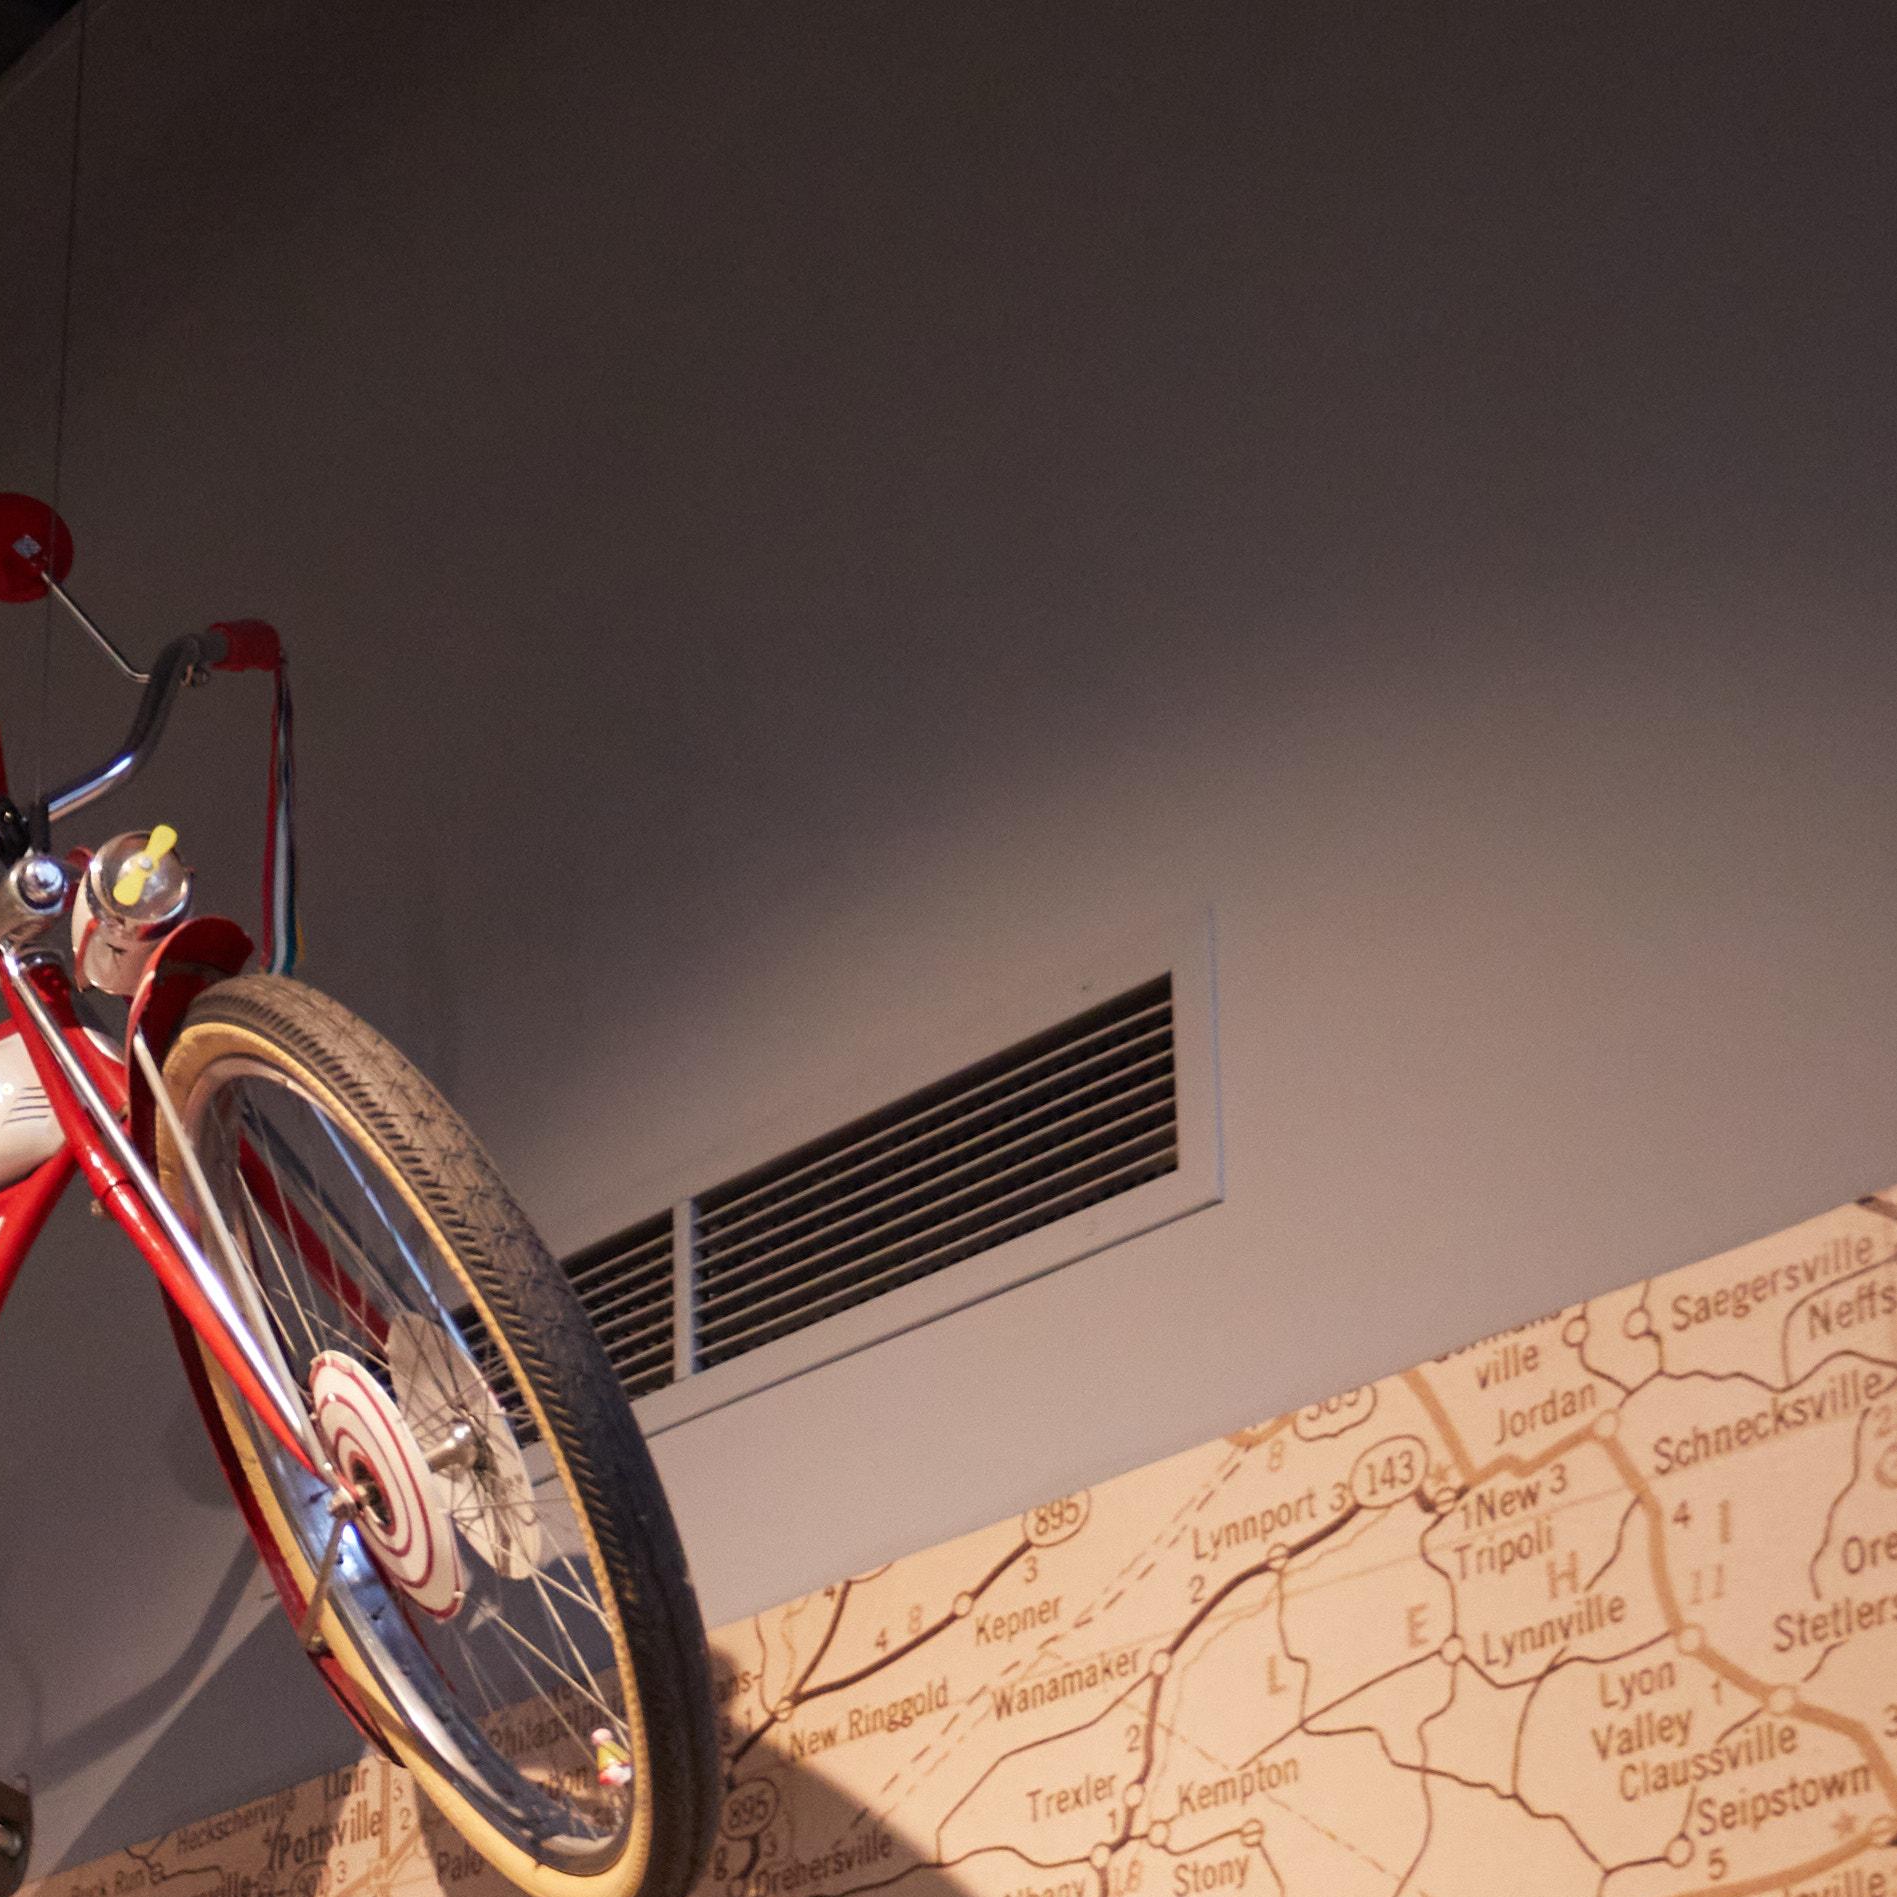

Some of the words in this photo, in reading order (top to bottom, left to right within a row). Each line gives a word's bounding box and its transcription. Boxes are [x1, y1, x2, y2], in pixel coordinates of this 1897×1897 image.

[1668, 1233, 1874, 1333] Saegersville
[1492, 1382, 1599, 1446] Jordan
[1652, 1369, 1884, 1477] Schnecksville
[1363, 1449, 1417, 1497] 143
[1190, 1491, 1320, 1562] Lynnport
[1453, 1517, 1555, 1582] Tripoli
[974, 1596, 1061, 1647] Kepner
[789, 1721, 838, 1761] New
[847, 1680, 950, 1745] Ringgold
[991, 1649, 1138, 1721] Wanamaker
[1176, 1757, 1301, 1817] Kempton
[1695, 1761, 1872, 1839] Seipstown
